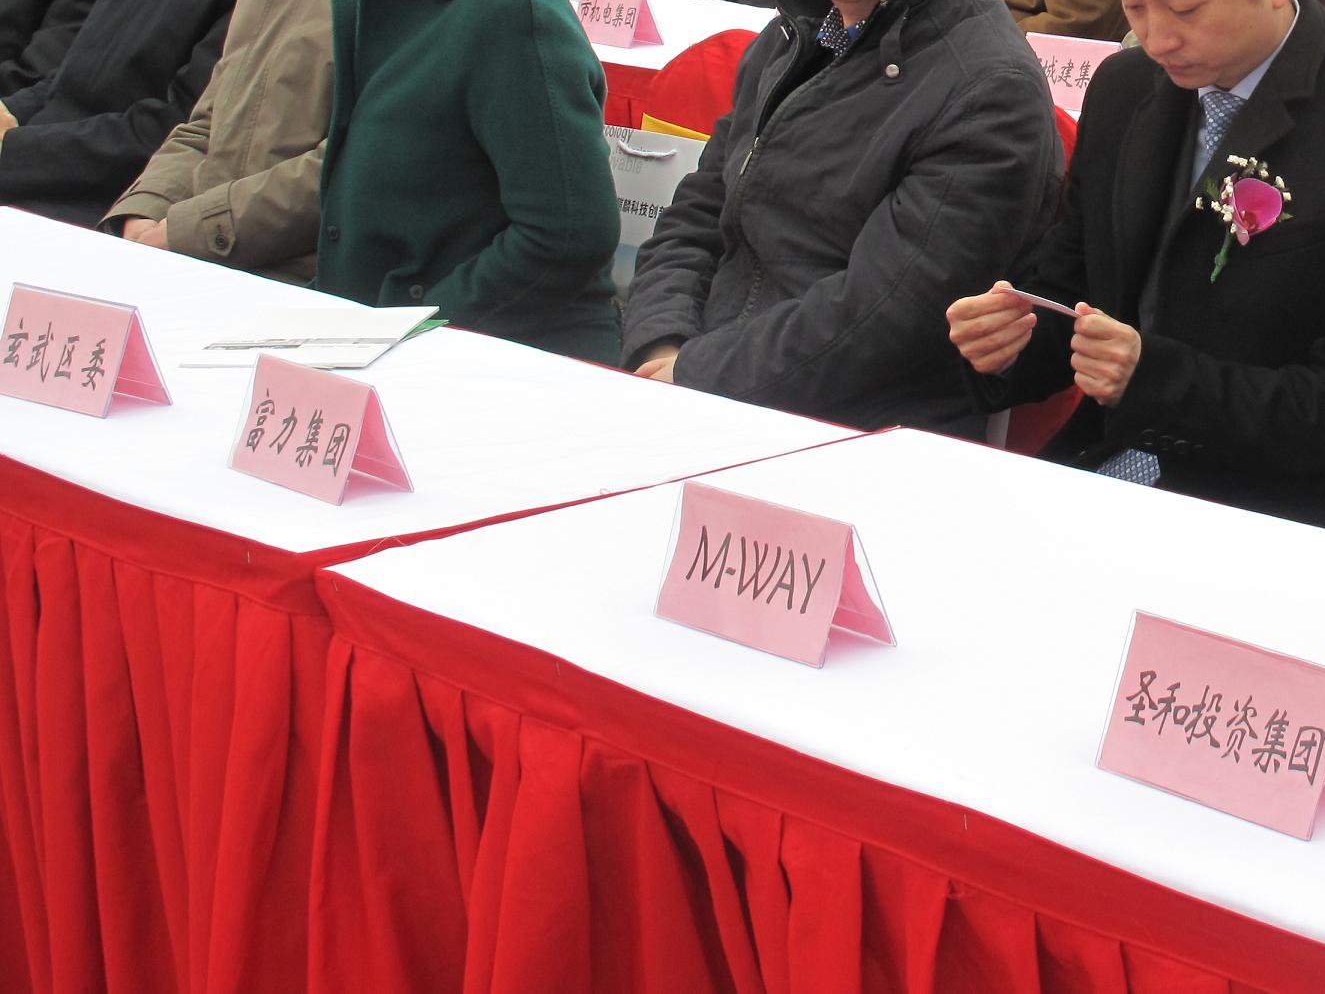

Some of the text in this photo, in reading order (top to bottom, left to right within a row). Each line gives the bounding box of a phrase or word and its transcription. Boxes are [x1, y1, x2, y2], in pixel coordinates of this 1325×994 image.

[1040, 55, 1091, 89] 城建集
[3, 317, 106, 391] 玄武区委
[245, 387, 351, 477] 富力集团
[685, 524, 826, 614] M-WAY
